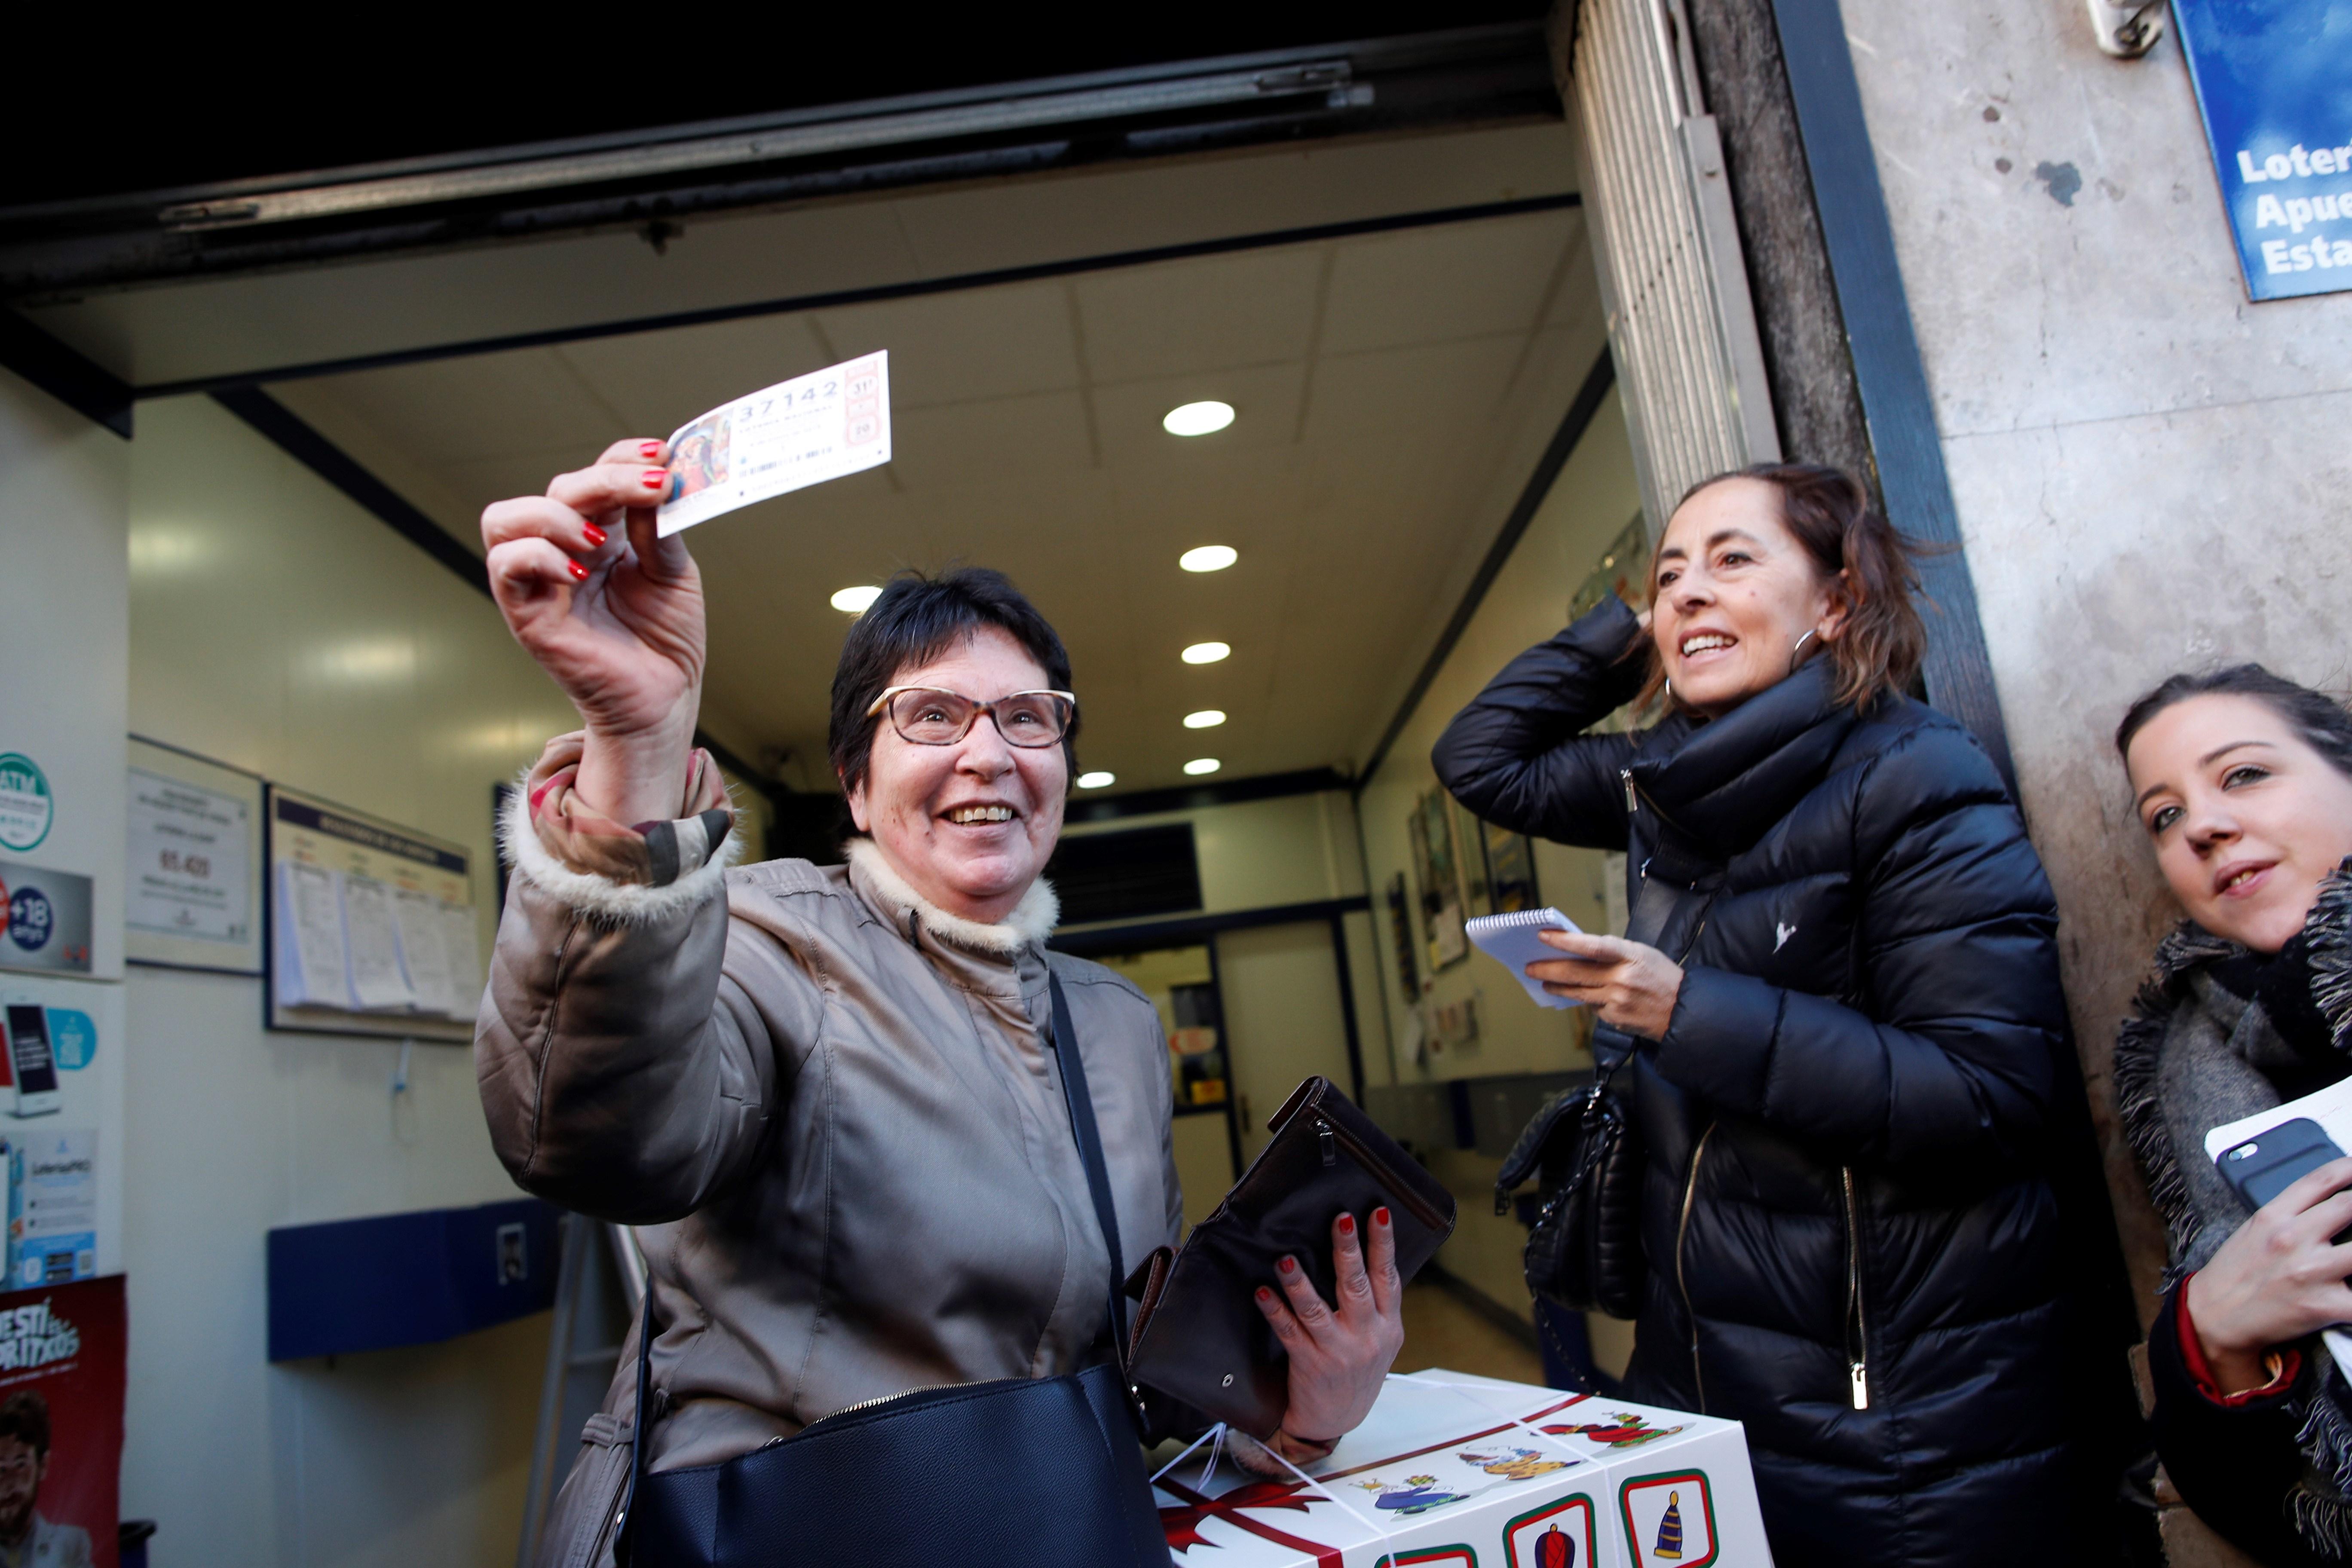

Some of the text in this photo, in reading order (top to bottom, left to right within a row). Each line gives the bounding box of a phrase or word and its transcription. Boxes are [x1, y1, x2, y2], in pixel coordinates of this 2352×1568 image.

[2237, 139, 2352, 184] Loter
[2256, 191, 2352, 234] Apue
[2261, 235, 2352, 275] Esta
[739, 381, 839, 422] 37142
[10, 898, 48, 927] +18
